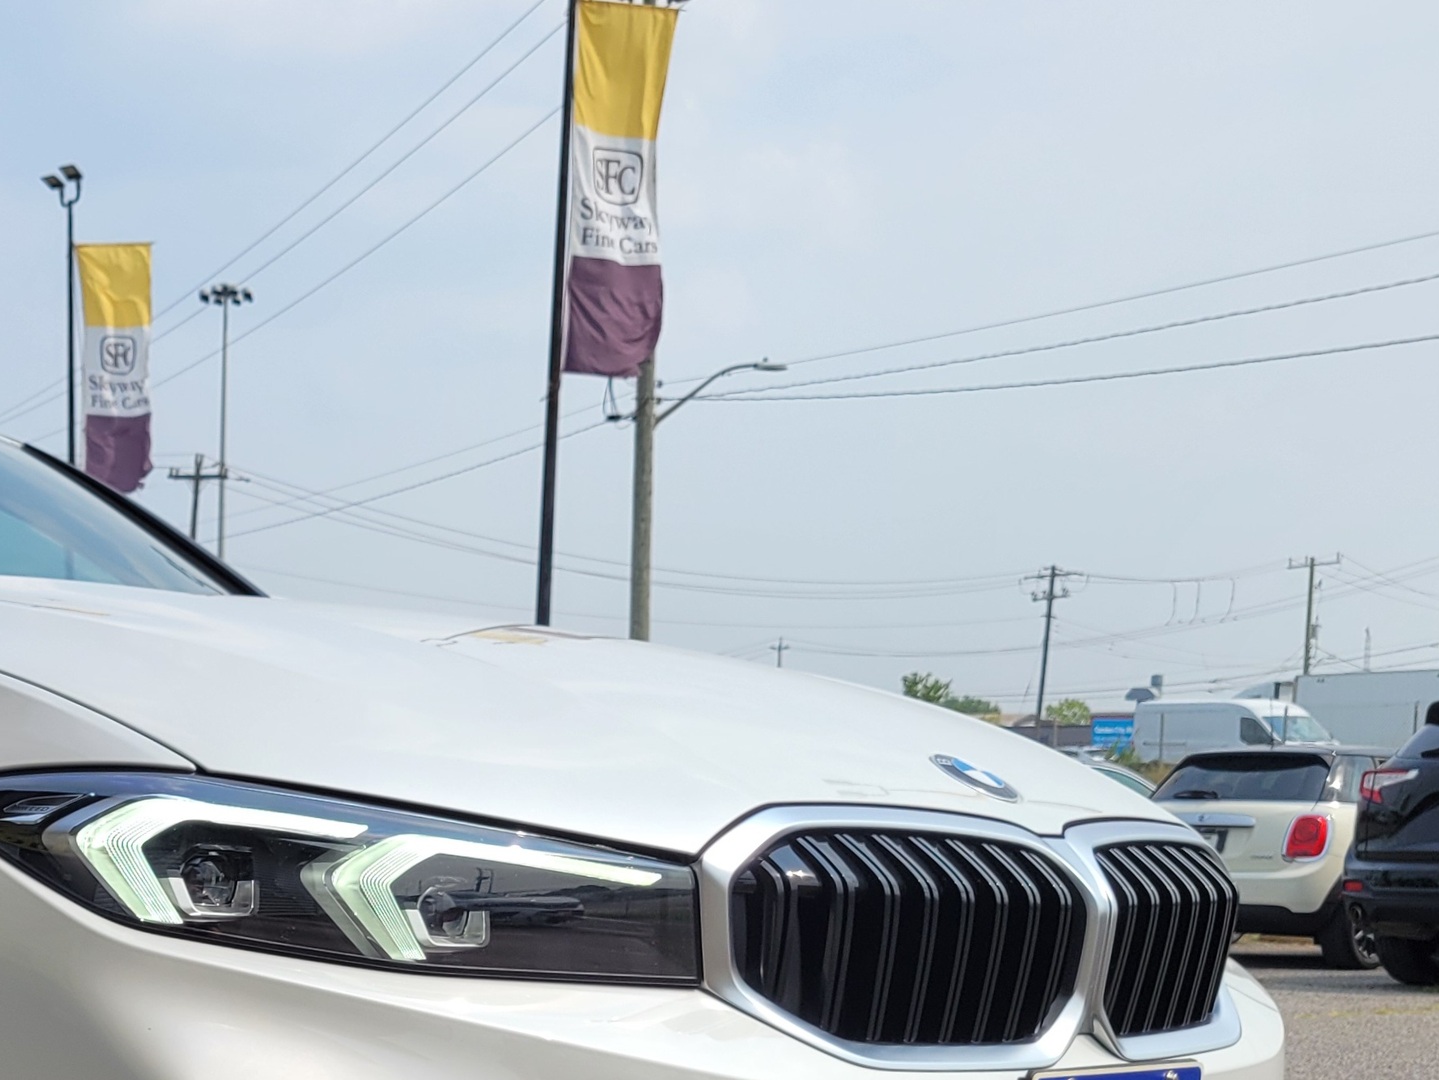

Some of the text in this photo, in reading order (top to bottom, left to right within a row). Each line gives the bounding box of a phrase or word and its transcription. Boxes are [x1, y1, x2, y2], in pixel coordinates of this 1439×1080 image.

[595, 157, 636, 196] SFC
[619, 235, 658, 255] Cars
[104, 342, 131, 368] SFC
